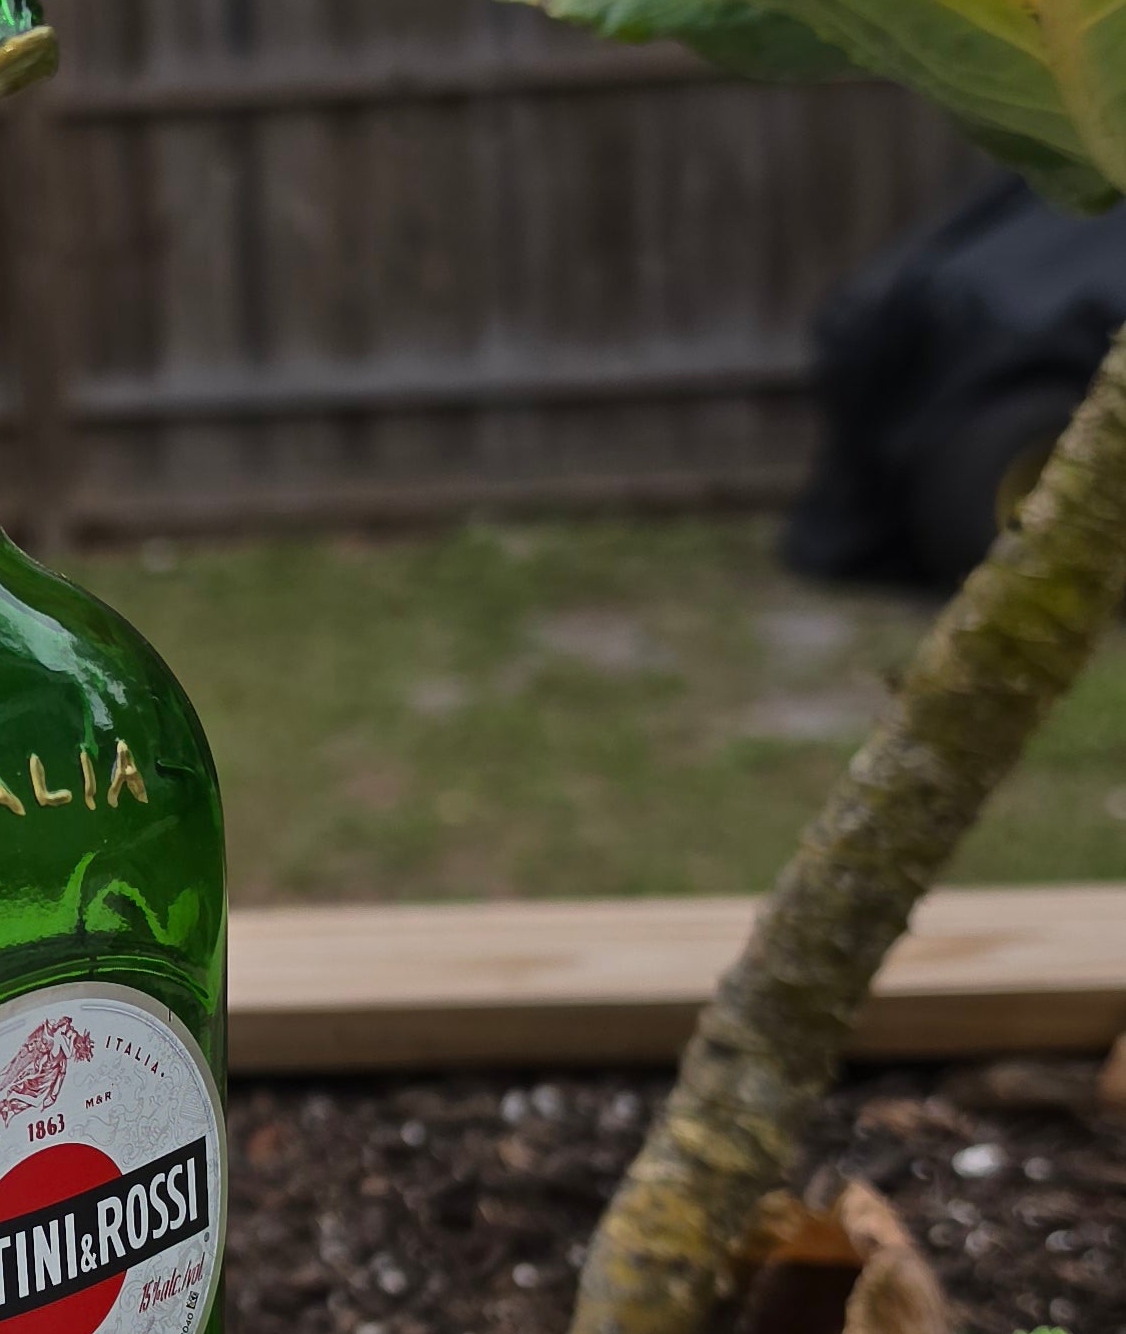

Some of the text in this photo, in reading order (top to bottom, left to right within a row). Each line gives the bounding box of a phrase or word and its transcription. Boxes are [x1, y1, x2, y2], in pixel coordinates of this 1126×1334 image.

[105, 1035, 158, 1075] ITALIA
[27, 1114, 65, 1142] 1863
[86, 1091, 112, 1109] M&R
